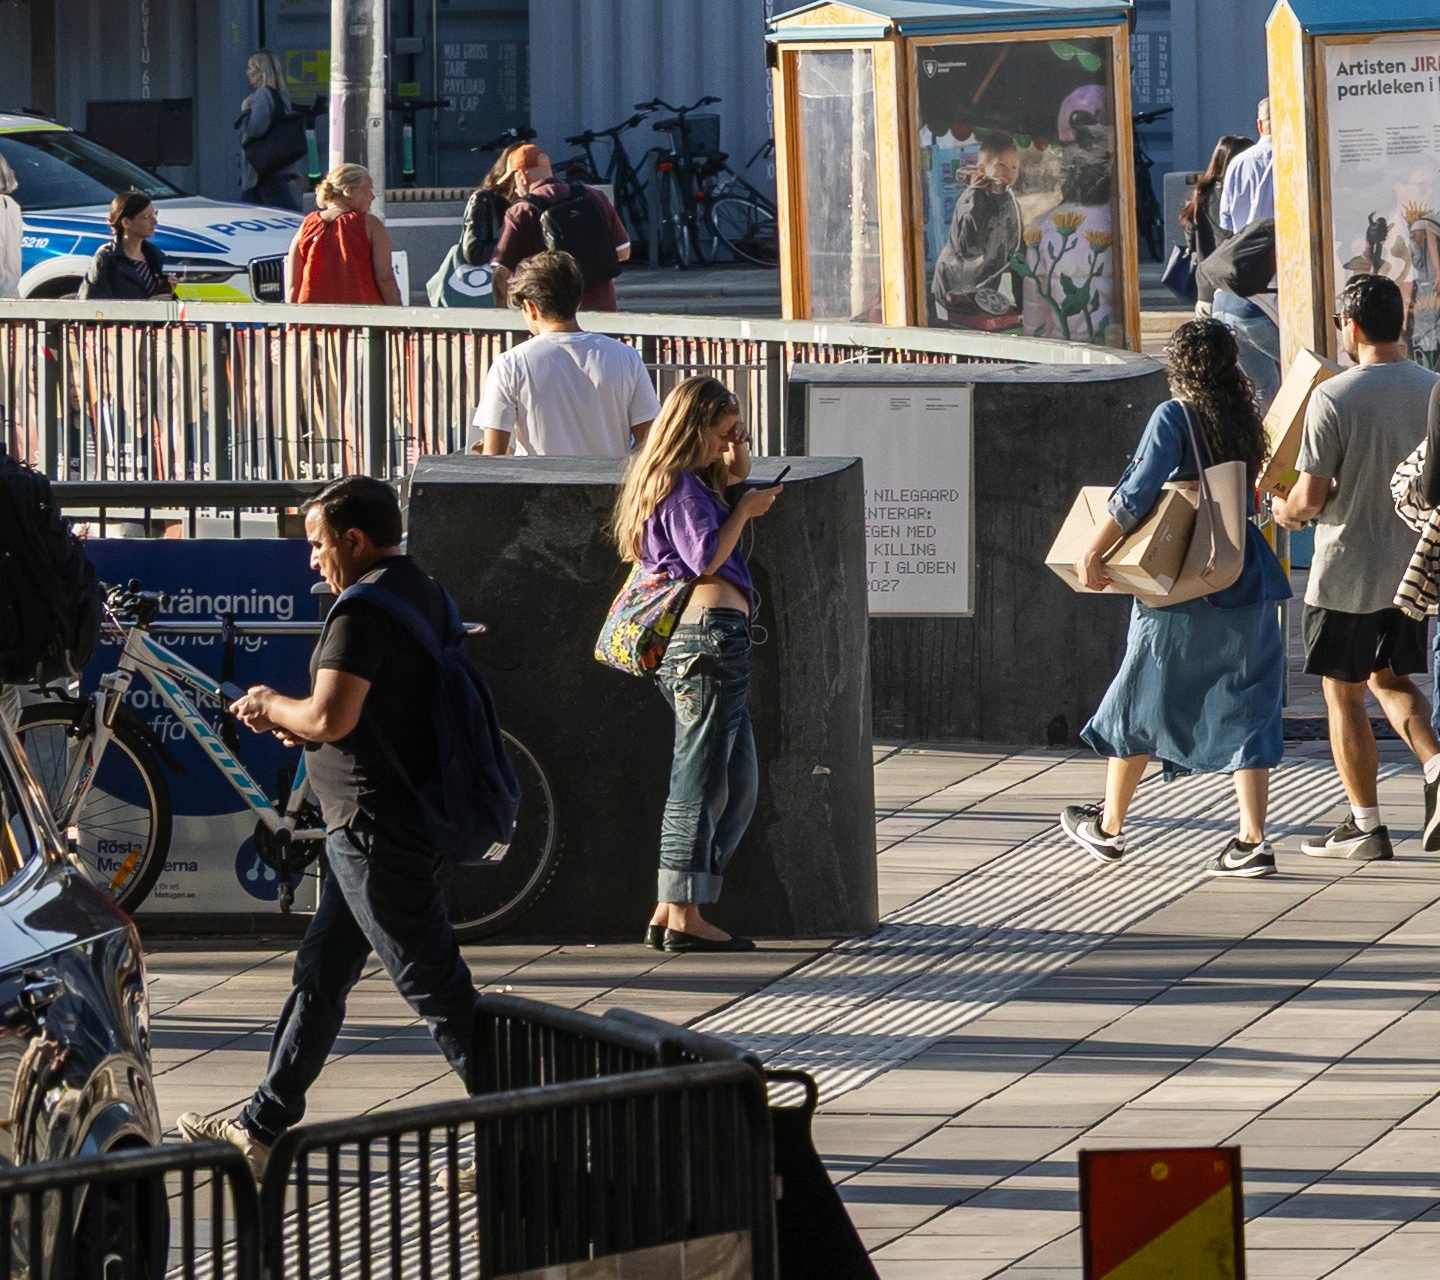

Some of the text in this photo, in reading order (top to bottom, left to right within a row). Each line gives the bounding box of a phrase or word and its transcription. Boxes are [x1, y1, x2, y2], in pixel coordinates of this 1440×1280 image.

[1336, 58, 1407, 77] Artisten
[444, 78, 486, 95] PAYLOAD
[1338, 78, 1425, 101] parkleken
[1428, 77, 1434, 92] i
[873, 489, 960, 502] NILEGAARD
[864, 507, 932, 520] NTERAR:
[864, 525, 937, 538] EGEN MED
[873, 543, 937, 556] KILLING
[884, 561, 956, 574] I GLOBEN
[158, 588, 294, 621] trängning
